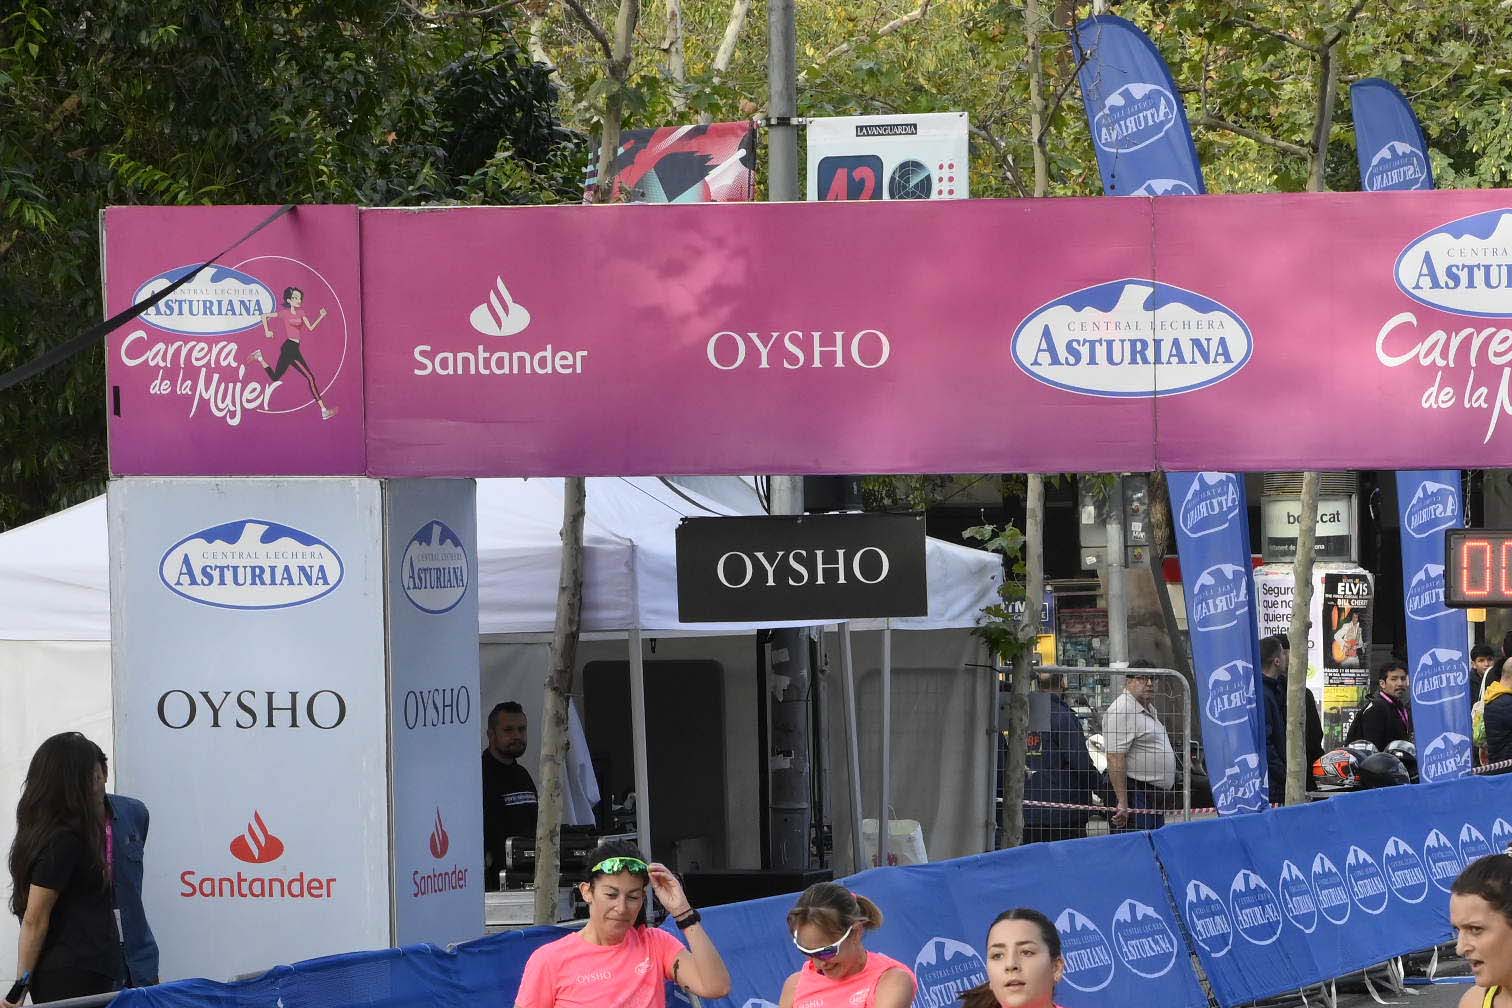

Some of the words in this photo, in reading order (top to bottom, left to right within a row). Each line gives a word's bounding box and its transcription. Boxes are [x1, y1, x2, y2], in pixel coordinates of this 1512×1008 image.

[145, 289, 264, 317] ASTURIANA
[172, 287, 210, 296] ENTRAL
[1067, 320, 1142, 332] CENTRAL
[1150, 319, 1226, 331] LECHERA
[121, 330, 238, 368] Carrera
[413, 345, 588, 375] Santander
[706, 329, 890, 370] OYSHO
[1030, 323, 1234, 368] ASTURIANA
[150, 370, 171, 395] de
[176, 369, 193, 395] la
[189, 364, 283, 426] Mujer
[1421, 371, 1455, 409] de
[1463, 368, 1489, 409] la
[174, 552, 331, 587] ASTURIANA
[202, 551, 261, 560] CENTRAL
[266, 550, 324, 560] LECHERA
[717, 546, 890, 589] OYSHO
[406, 560, 465, 592] ASTURIANA
[1337, 582, 1368, 596] ELVIS
[156, 689, 347, 730] OYSHO
[404, 685, 471, 730] OYSHO
[180, 870, 337, 899] Santander
[413, 865, 469, 899] Santander
